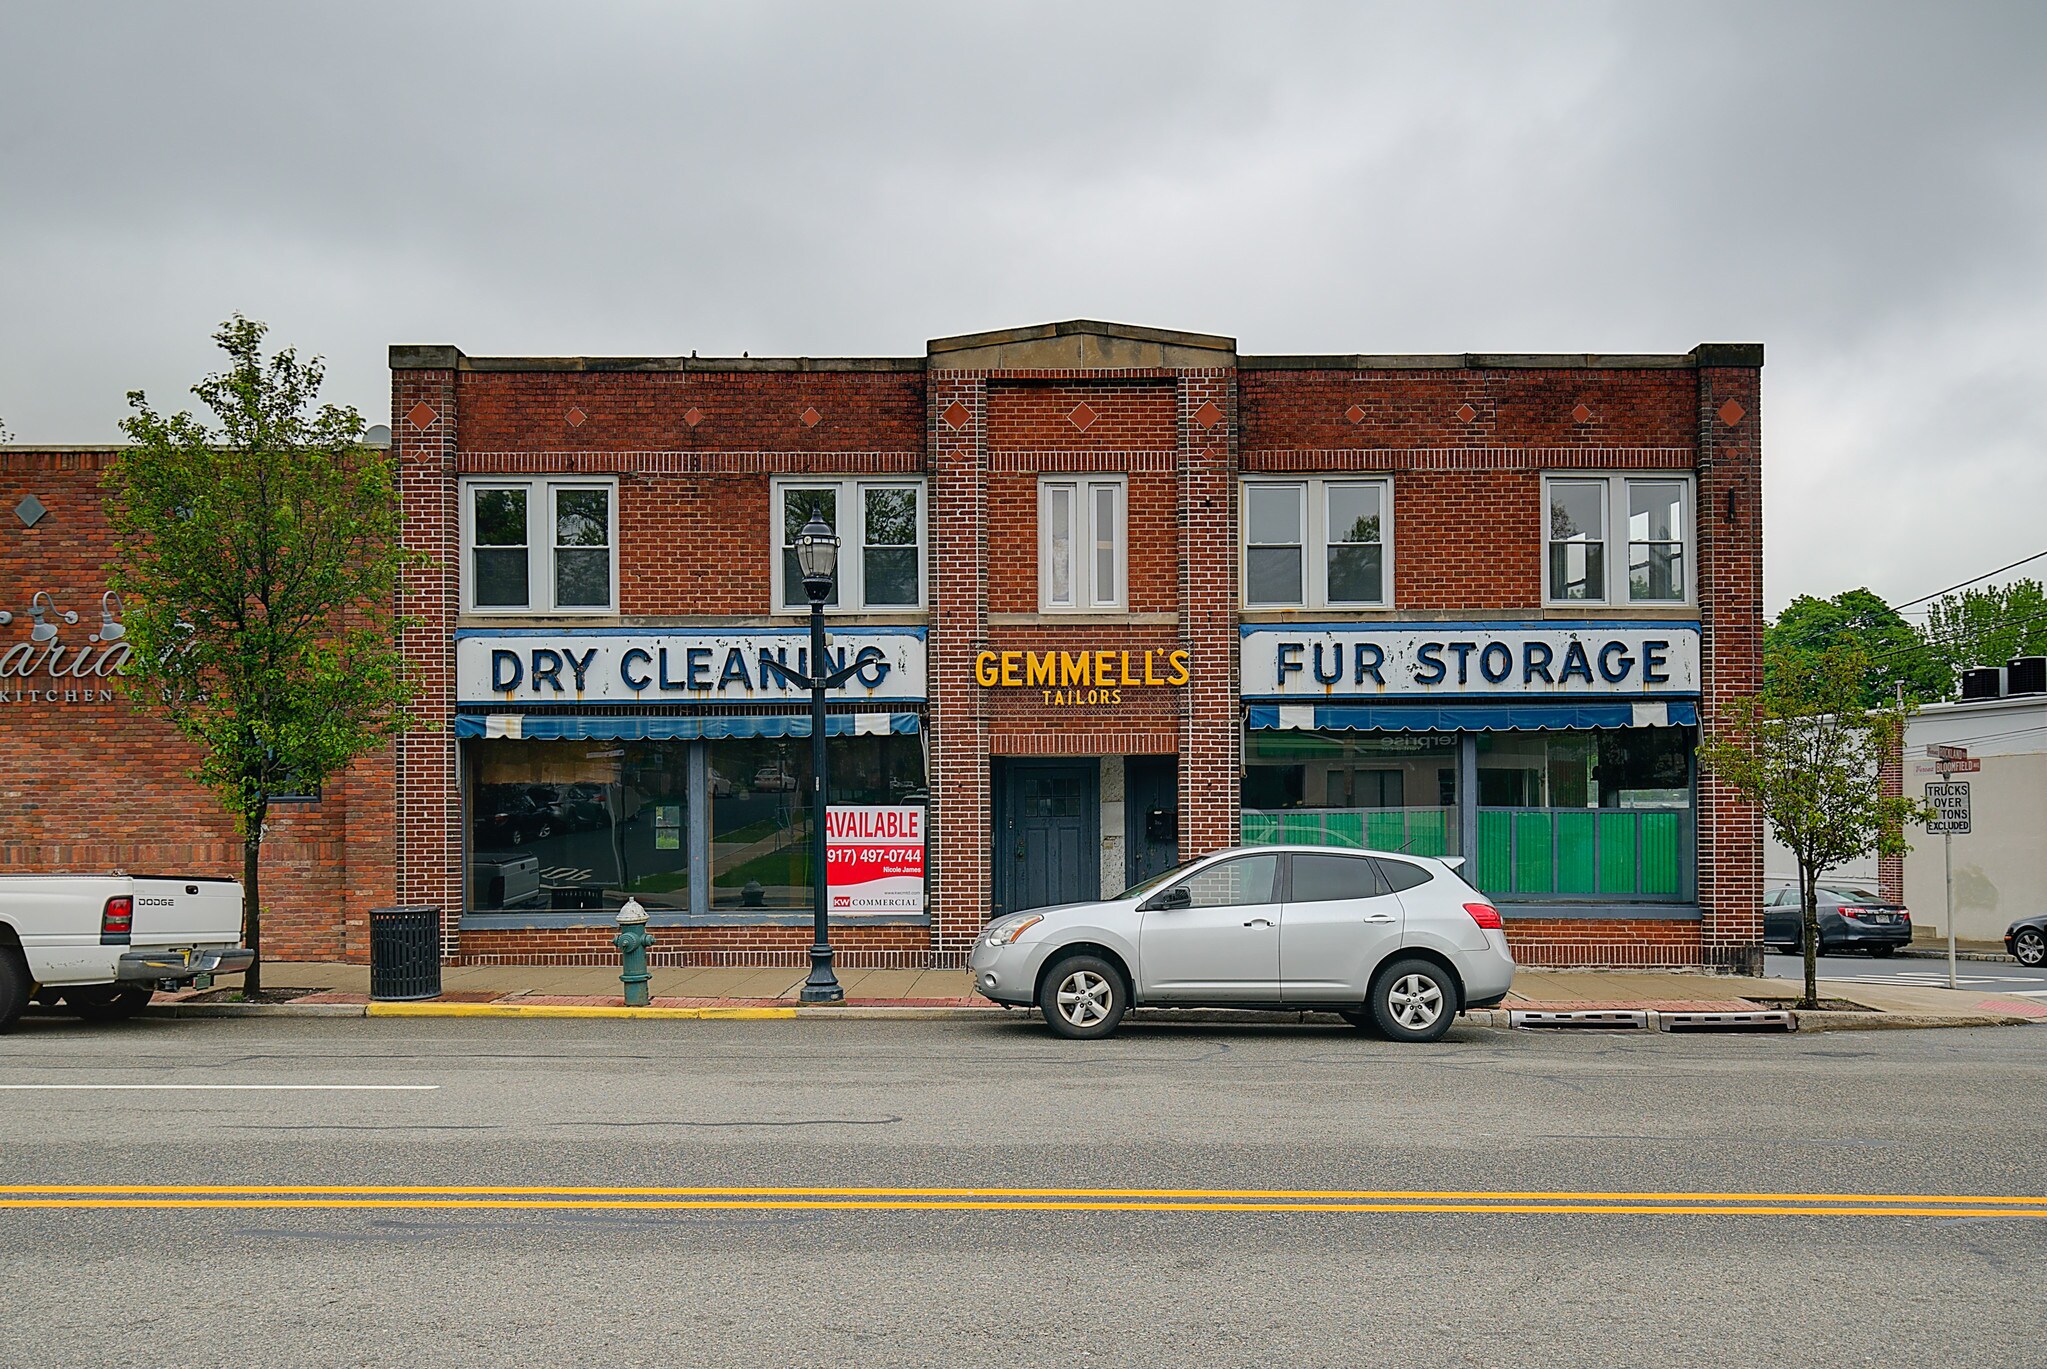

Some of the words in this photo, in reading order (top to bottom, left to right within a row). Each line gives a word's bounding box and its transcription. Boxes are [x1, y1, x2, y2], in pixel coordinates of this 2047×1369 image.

[491, 648, 599, 692] DRY
[620, 645, 892, 690] CLEANING
[975, 648, 1190, 687] GEMMELL'S
[1277, 642, 1386, 686] FUR
[1413, 640, 1670, 684] STORAGE
[0, 689, 113, 703] KITCHEN
[1042, 689, 1122, 705] TAILORS
[1936, 761, 1973, 772] BLOOMFIELD
[1927, 785, 1968, 796] TRUCKS
[1934, 797, 1962, 808] OVER
[1941, 809, 1968, 820] TONS
[826, 811, 918, 838] AVAILABLE
[1928, 821, 1969, 830] EXCLUDED
[827, 848, 857, 866] 917)
[860, 848, 921, 863] 497-0744
[138, 898, 175, 907] DODGE
[834, 898, 850, 907] KW
